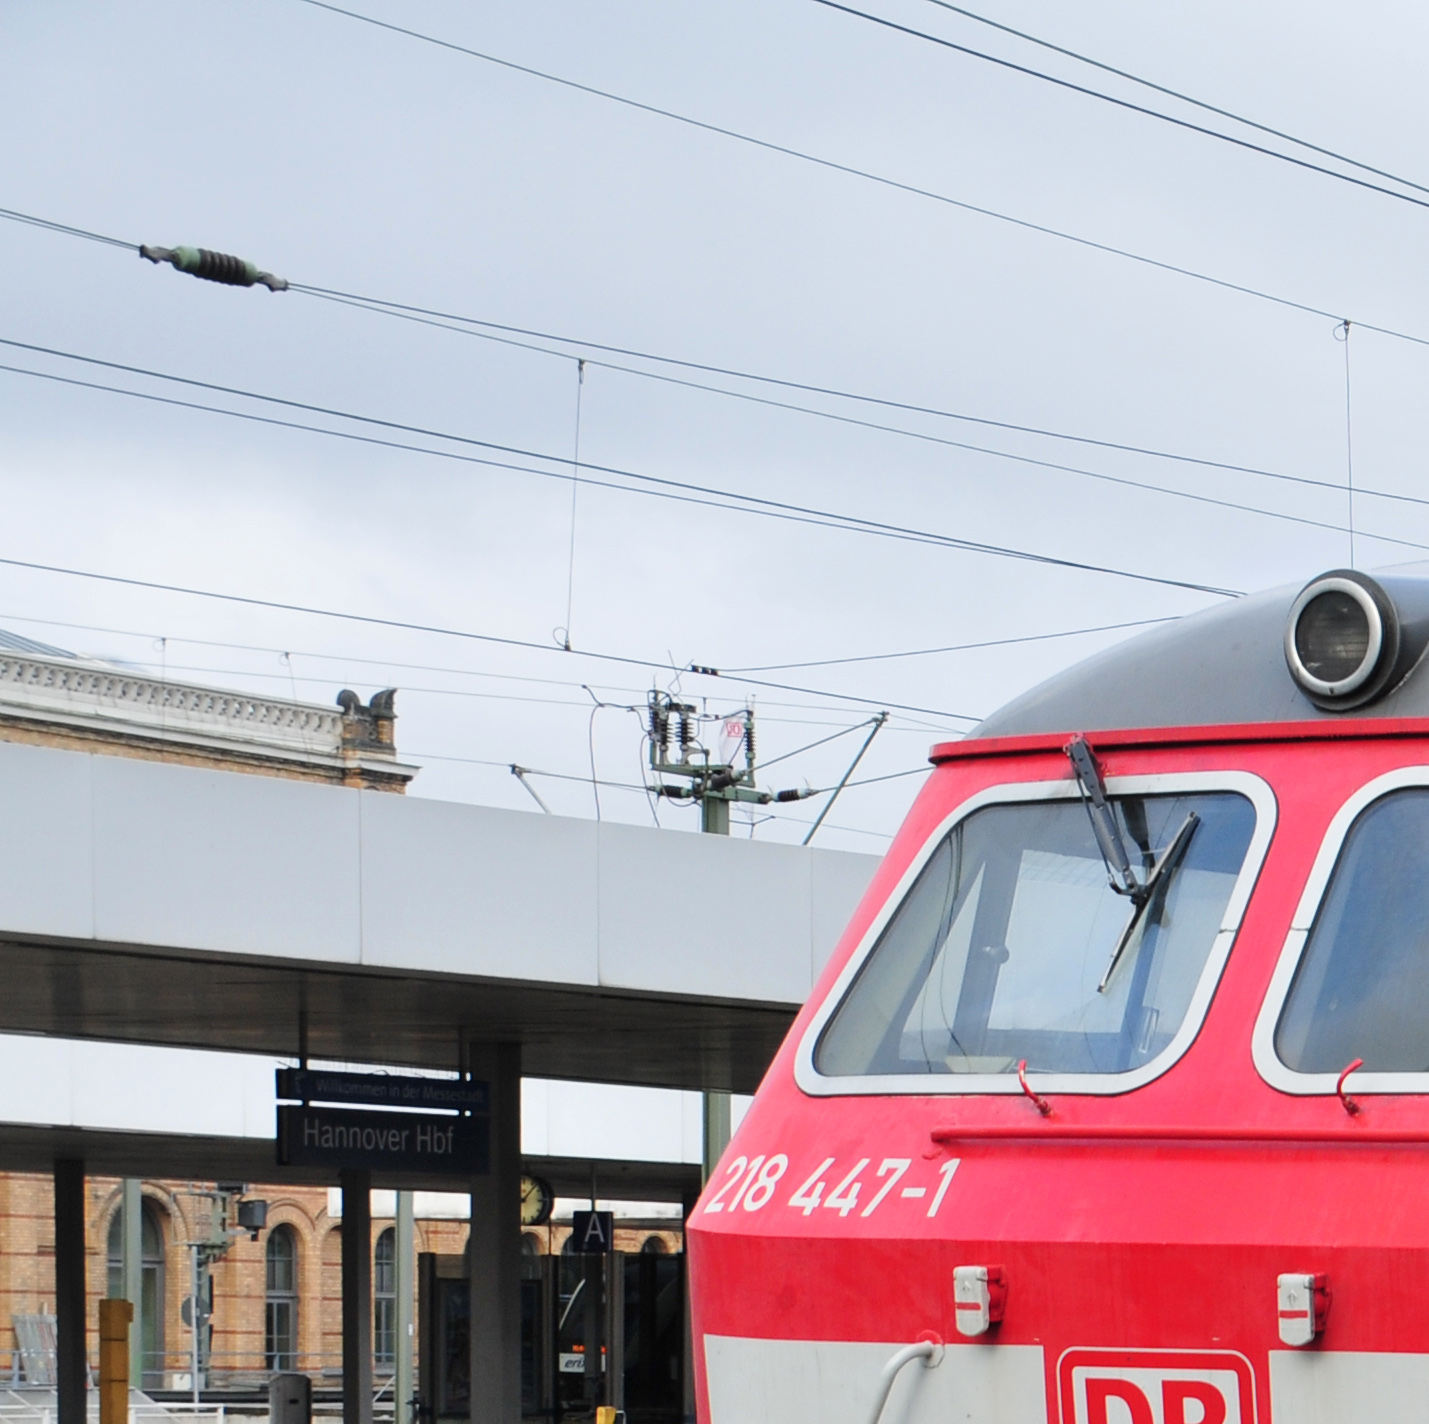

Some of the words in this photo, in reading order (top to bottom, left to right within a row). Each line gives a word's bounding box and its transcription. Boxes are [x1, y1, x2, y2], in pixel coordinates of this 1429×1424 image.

[315, 1079, 387, 1097] Willkommen
[389, 1083, 400, 1097] in
[402, 1084, 420, 1098] der
[304, 1117, 409, 1151] Hannover
[417, 1123, 454, 1154] Hbf
[704, 1153, 789, 1214] 218
[788, 1157, 961, 1217] 447-1
[584, 1213, 605, 1243] A
